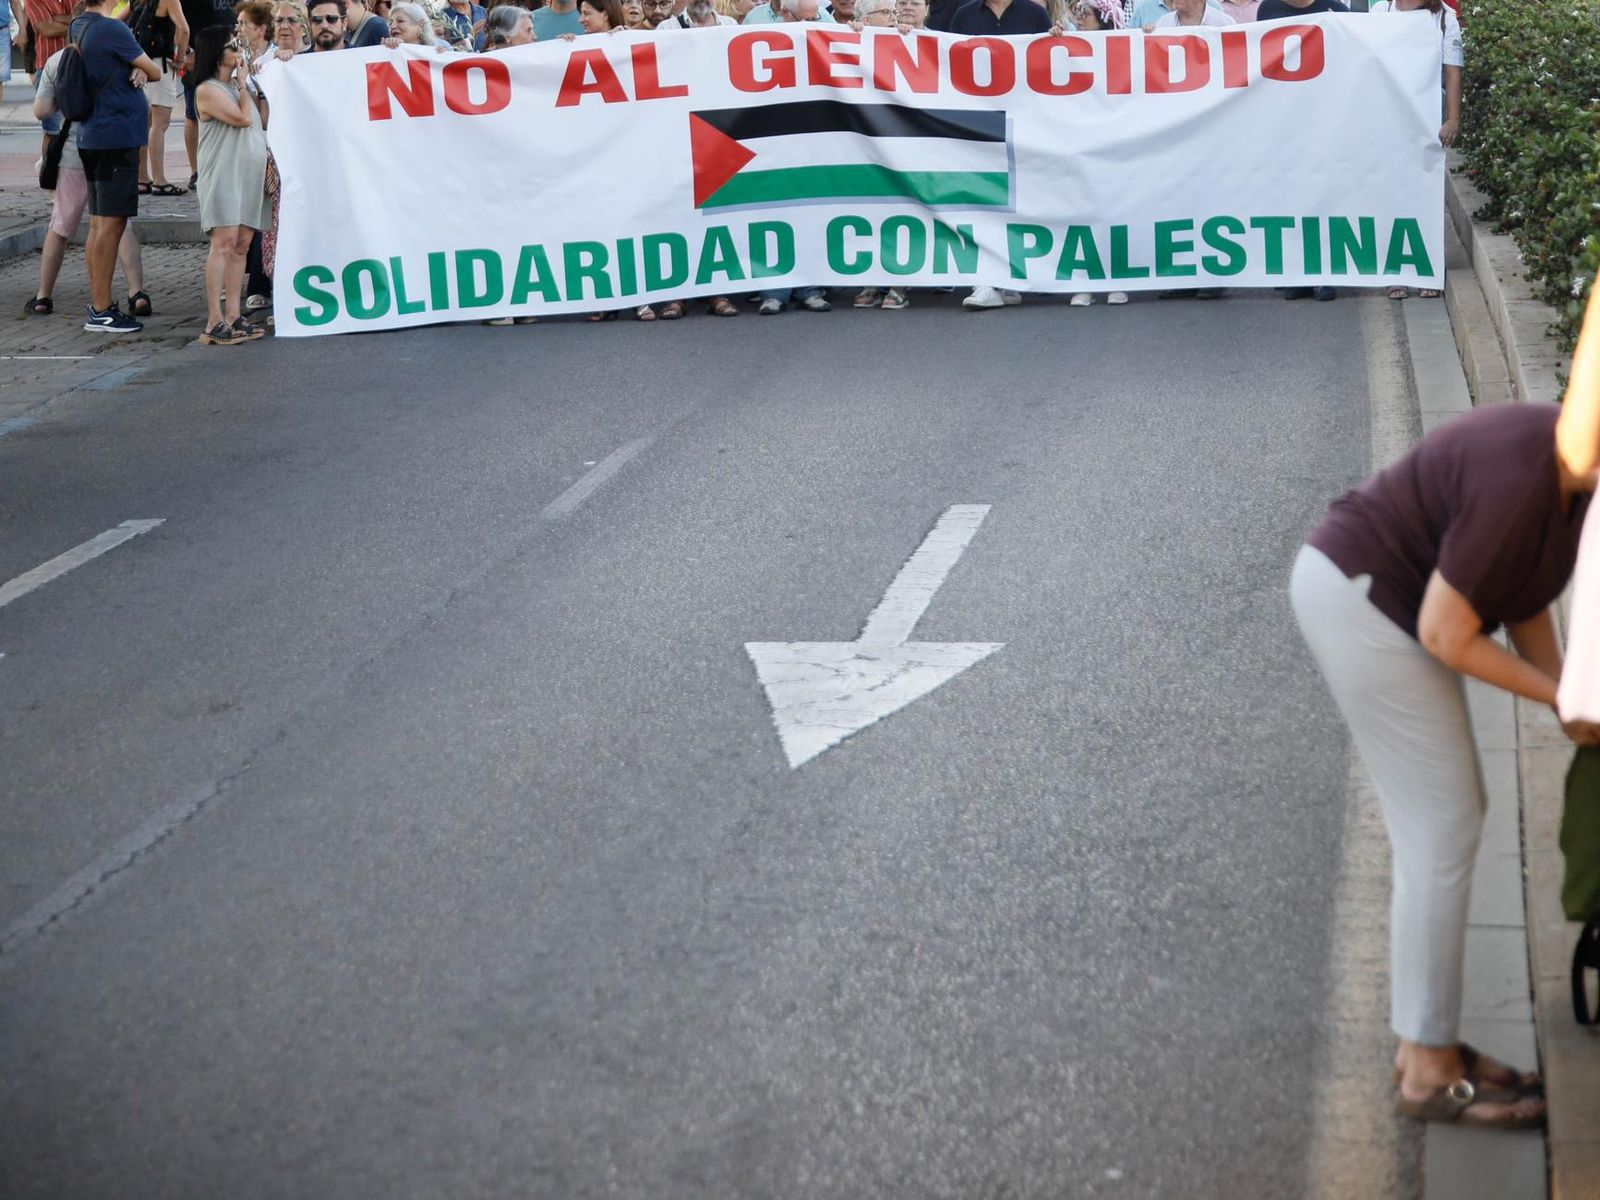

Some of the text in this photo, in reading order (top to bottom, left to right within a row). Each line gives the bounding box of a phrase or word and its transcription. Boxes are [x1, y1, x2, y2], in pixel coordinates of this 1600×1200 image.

[366, 24, 1325, 121] NO AL GENOCIDIO
[293, 215, 1434, 326] SOLIDARIDAD CON PALESTINA
